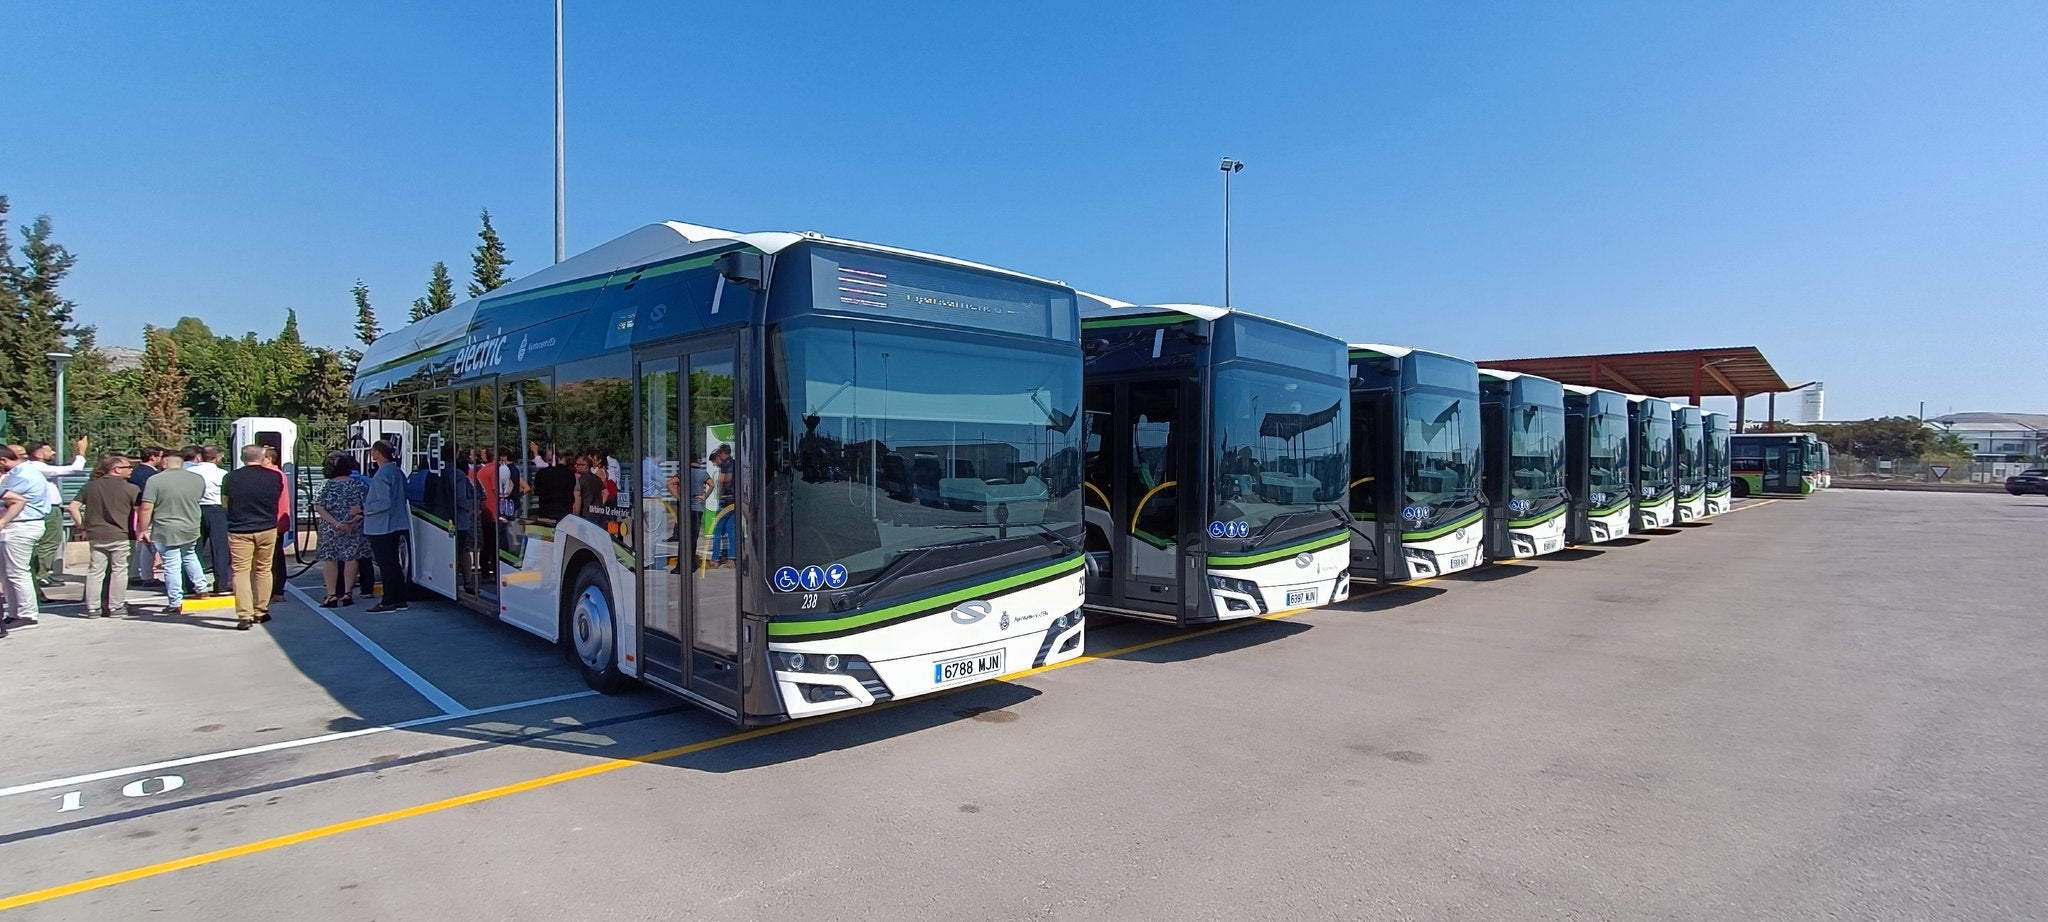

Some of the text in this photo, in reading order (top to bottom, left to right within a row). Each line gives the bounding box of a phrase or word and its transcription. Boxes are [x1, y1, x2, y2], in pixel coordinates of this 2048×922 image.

[801, 593, 818, 609] 238
[944, 655, 999, 679] 6788 MJN
